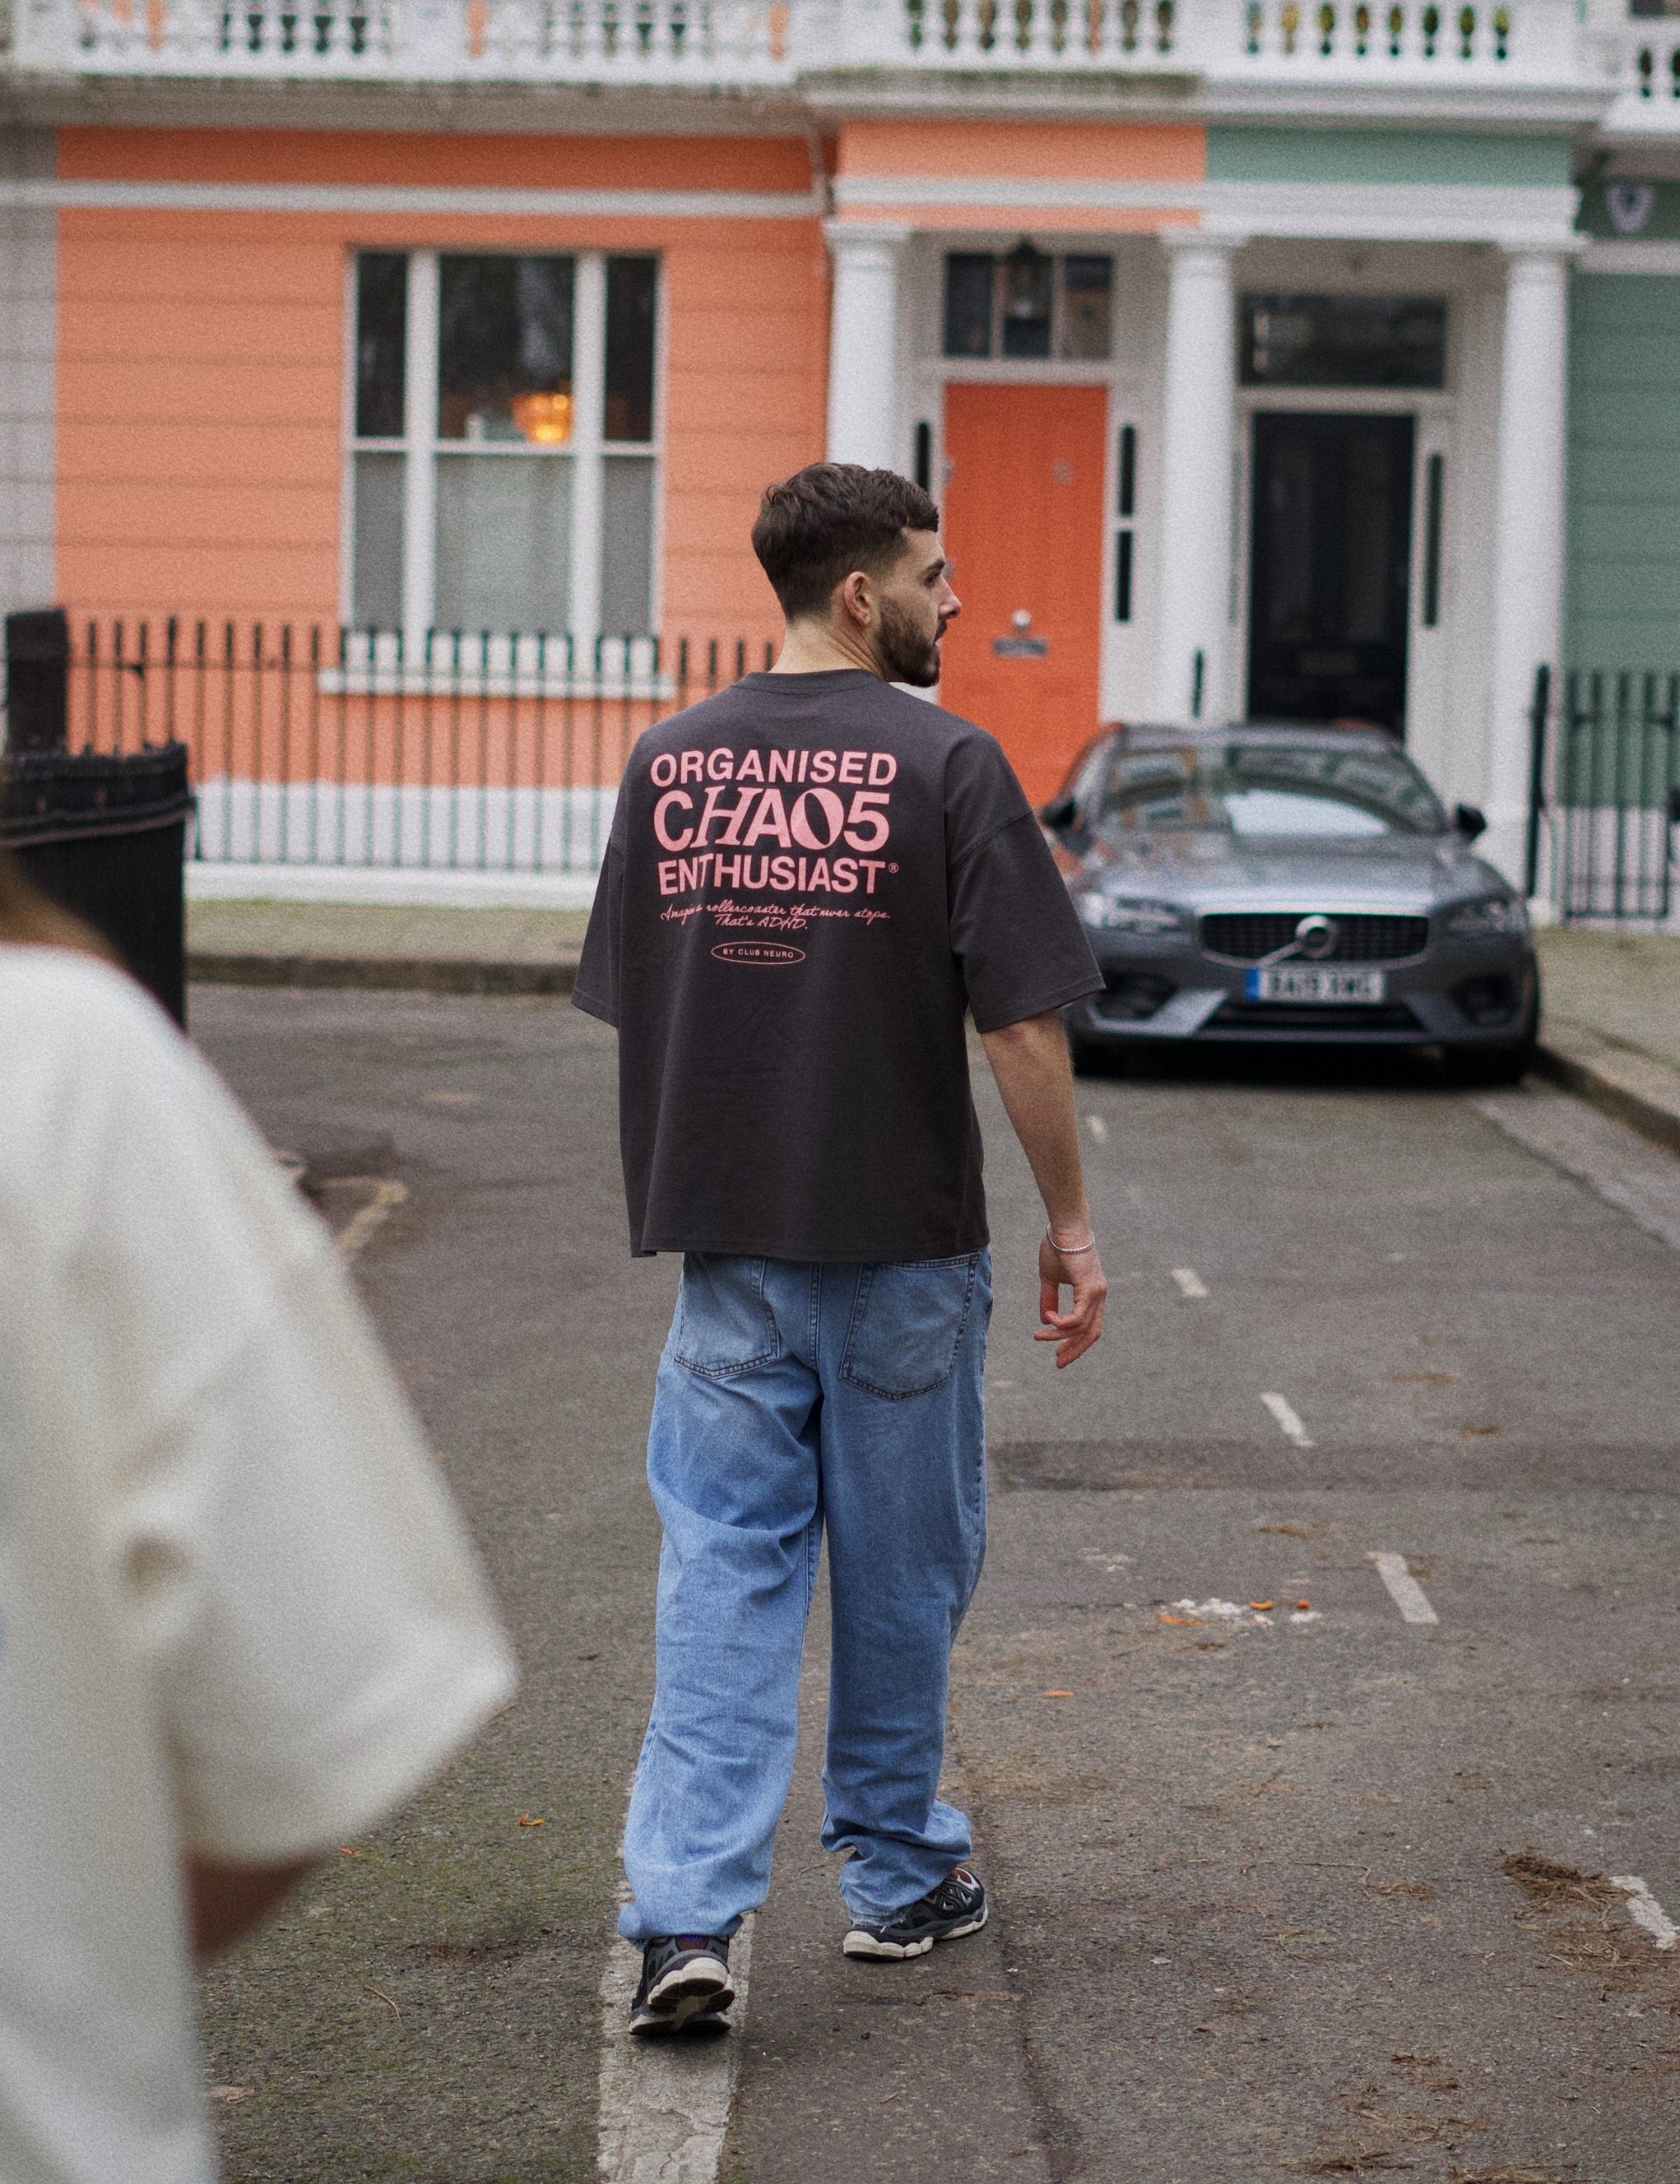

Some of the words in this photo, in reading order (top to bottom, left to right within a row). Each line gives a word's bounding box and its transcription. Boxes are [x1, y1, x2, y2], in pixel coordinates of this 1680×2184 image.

[650, 747, 897, 787] ORGANISED
[706, 899, 786, 915] rollercoaster
[790, 903, 821, 917] that
[819, 909, 850, 918] never
[714, 913, 755, 927] That's
[764, 950, 794, 958] NEURO
